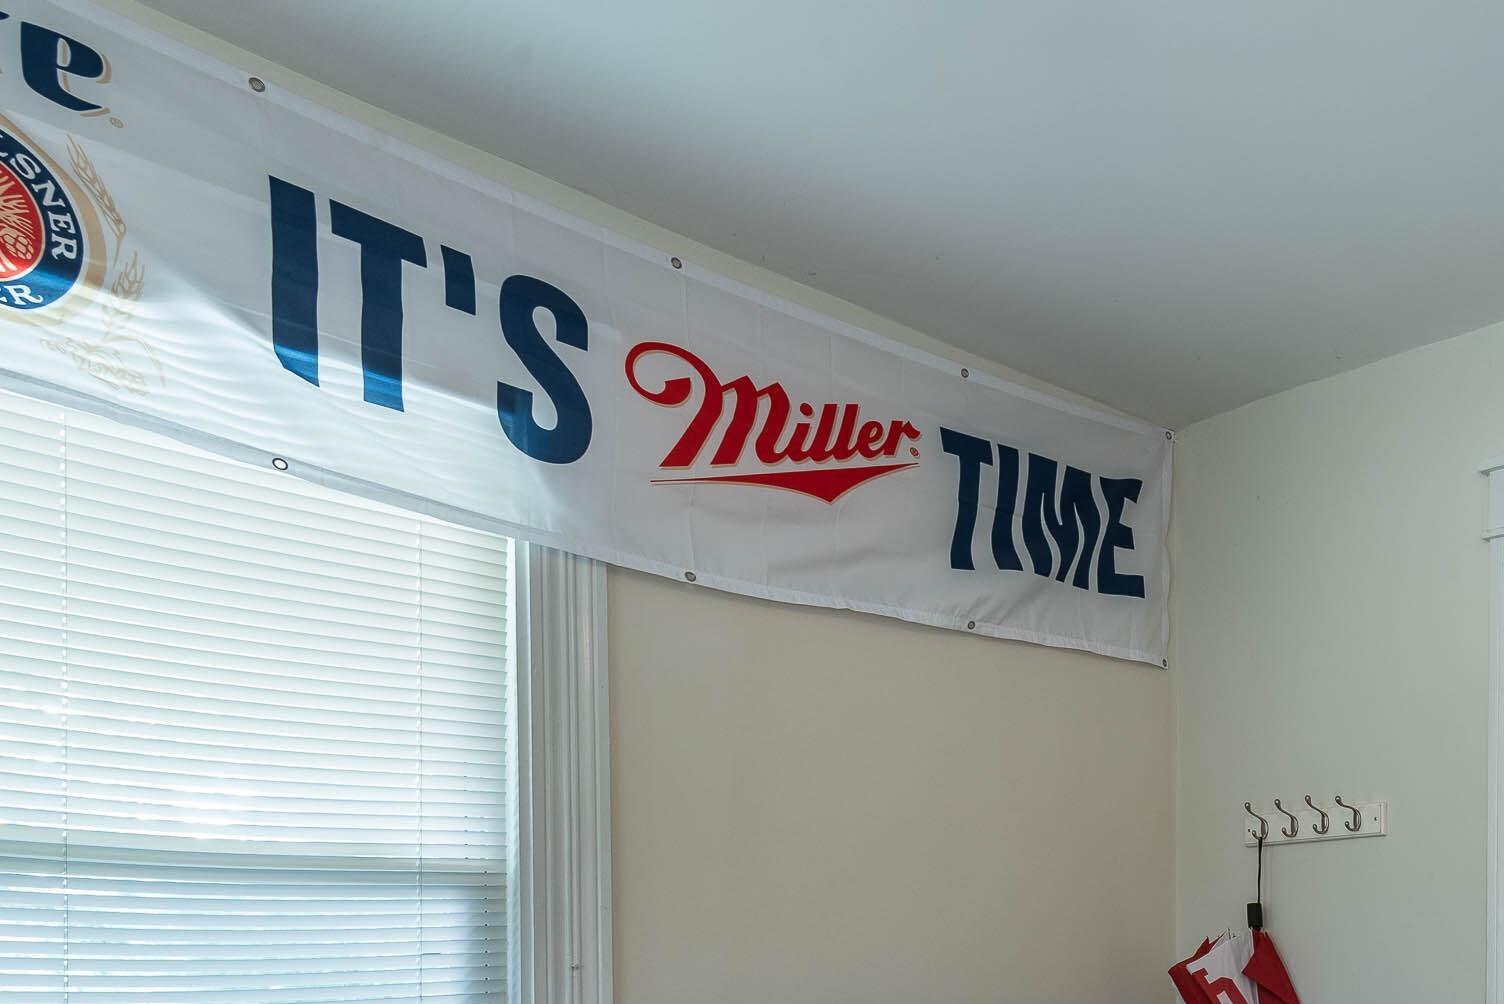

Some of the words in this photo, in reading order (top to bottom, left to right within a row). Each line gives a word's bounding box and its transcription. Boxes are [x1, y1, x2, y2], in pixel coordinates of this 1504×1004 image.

[0, 10, 107, 114] e
[0, 142, 78, 261] SNER
[267, 174, 593, 465] IT'S
[625, 341, 921, 469] Miller
[940, 426, 1146, 599] TIME
